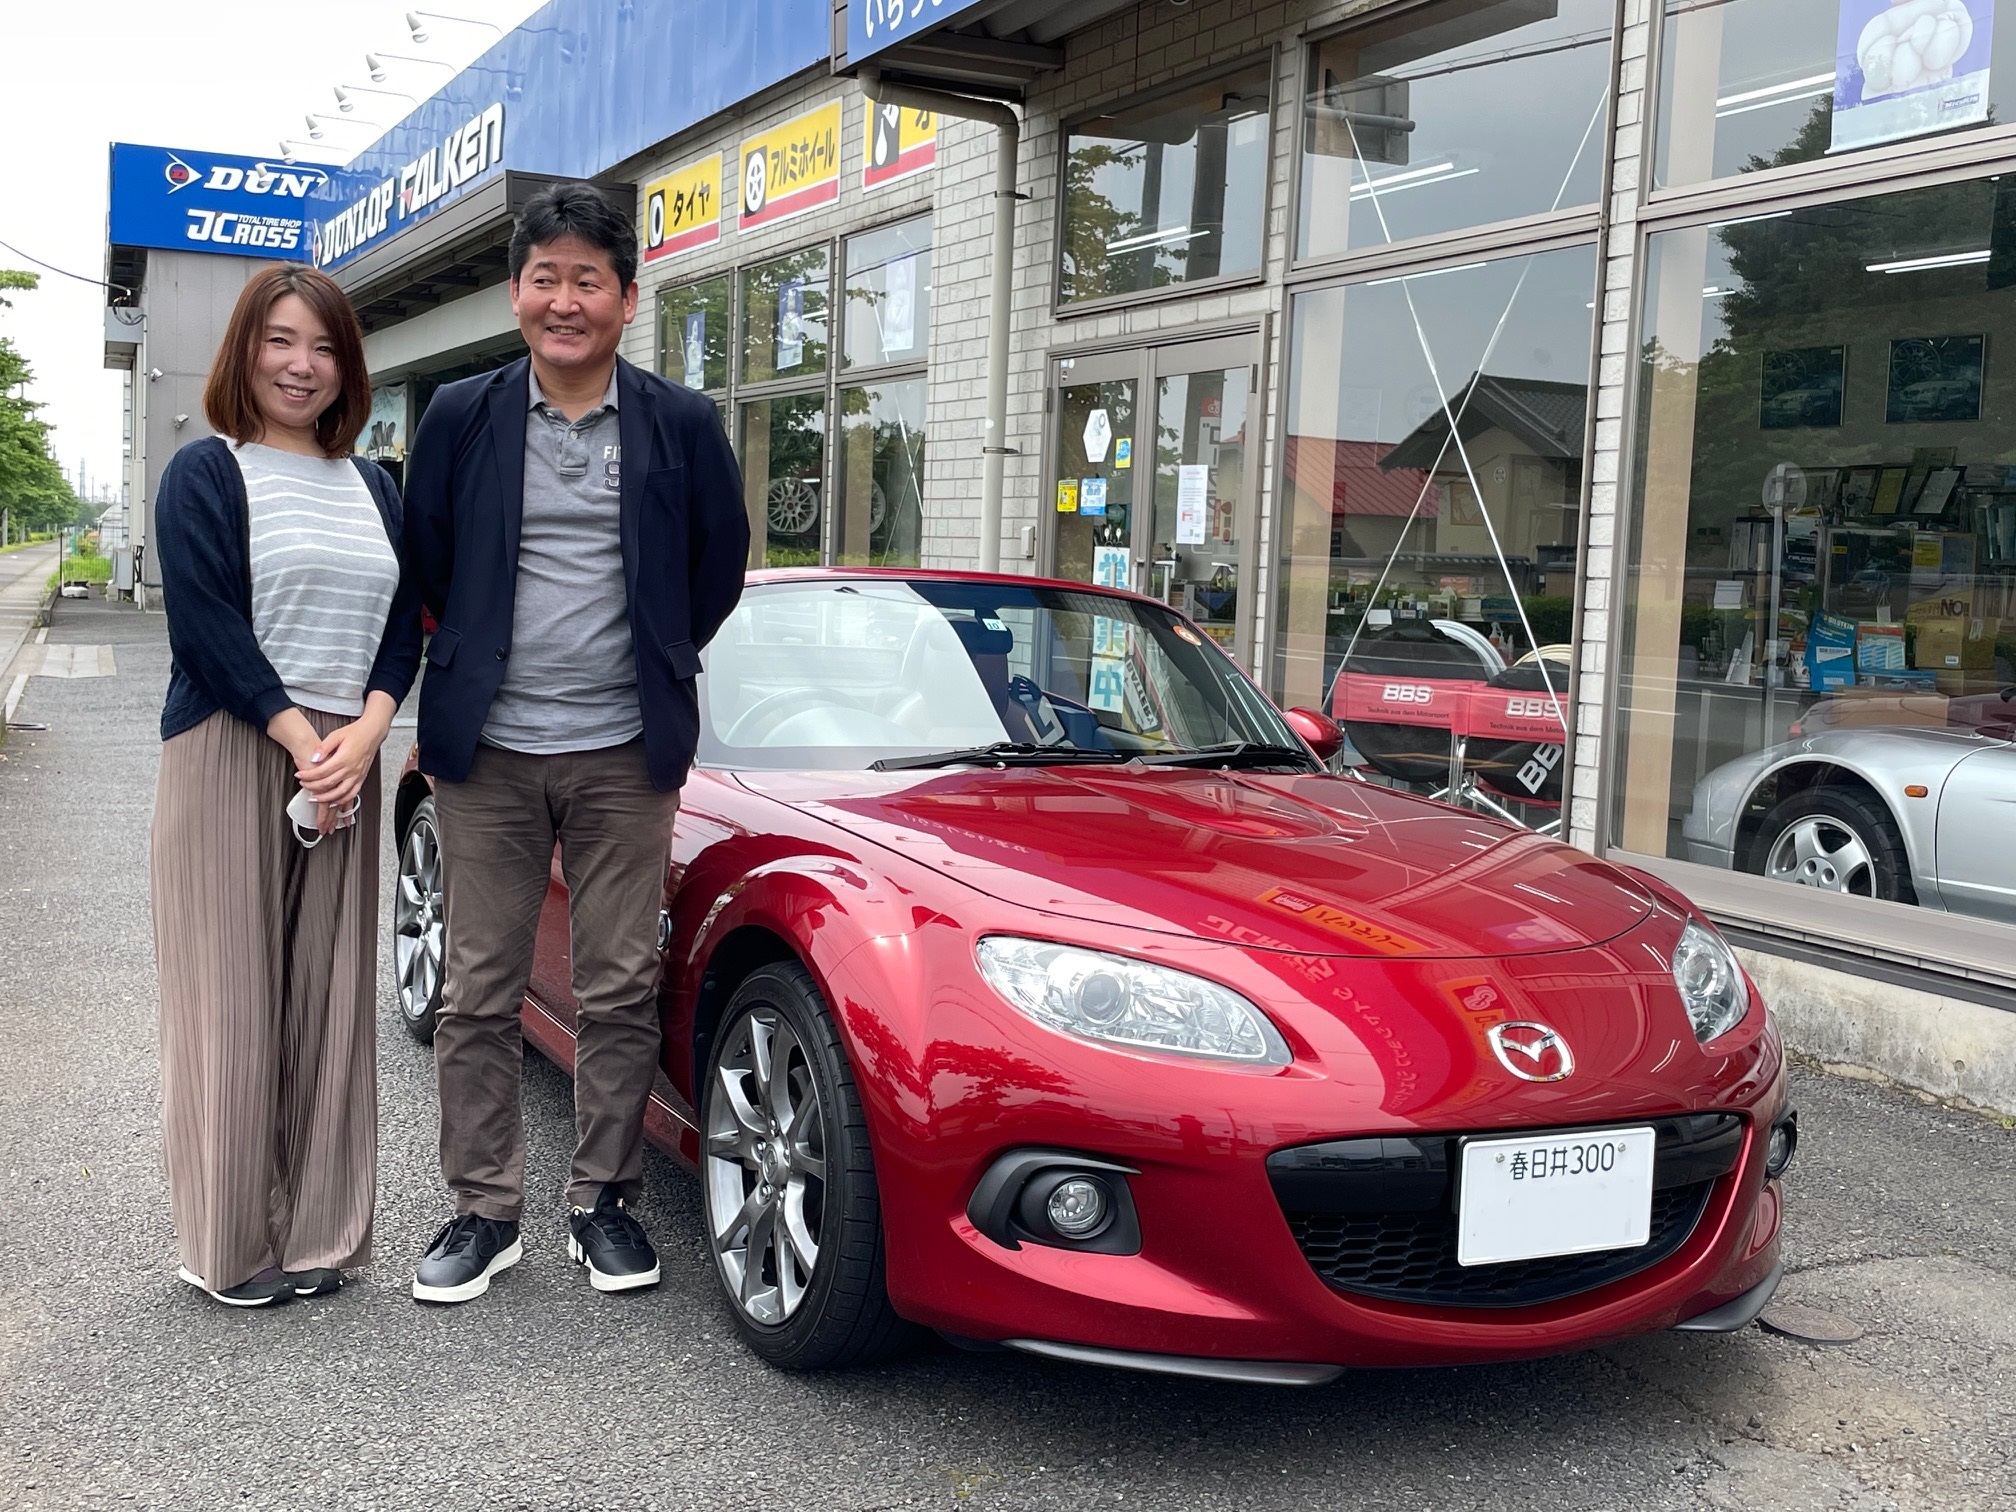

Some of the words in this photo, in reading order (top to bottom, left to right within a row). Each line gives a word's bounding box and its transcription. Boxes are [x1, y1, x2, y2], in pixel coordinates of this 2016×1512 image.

[398, 102, 505, 221] FALKEN
[770, 127, 835, 191] アルミホイール
[203, 165, 329, 198] DUN
[673, 180, 711, 227] タイヤ
[237, 213, 262, 225] TOTAL
[261, 216, 280, 227] TIRE
[280, 217, 302, 229] SHOP
[322, 177, 395, 266] DUNLOP
[604, 445, 621, 460] FI
[1382, 683, 1434, 706] BBS
[1367, 706, 1389, 715] Technik
[1402, 708, 1416, 716] dem
[1416, 709, 1450, 719] Motorsport
[1506, 697, 1562, 720] BBS
[1489, 721, 1515, 730] Technik
[1529, 724, 1544, 732] dem
